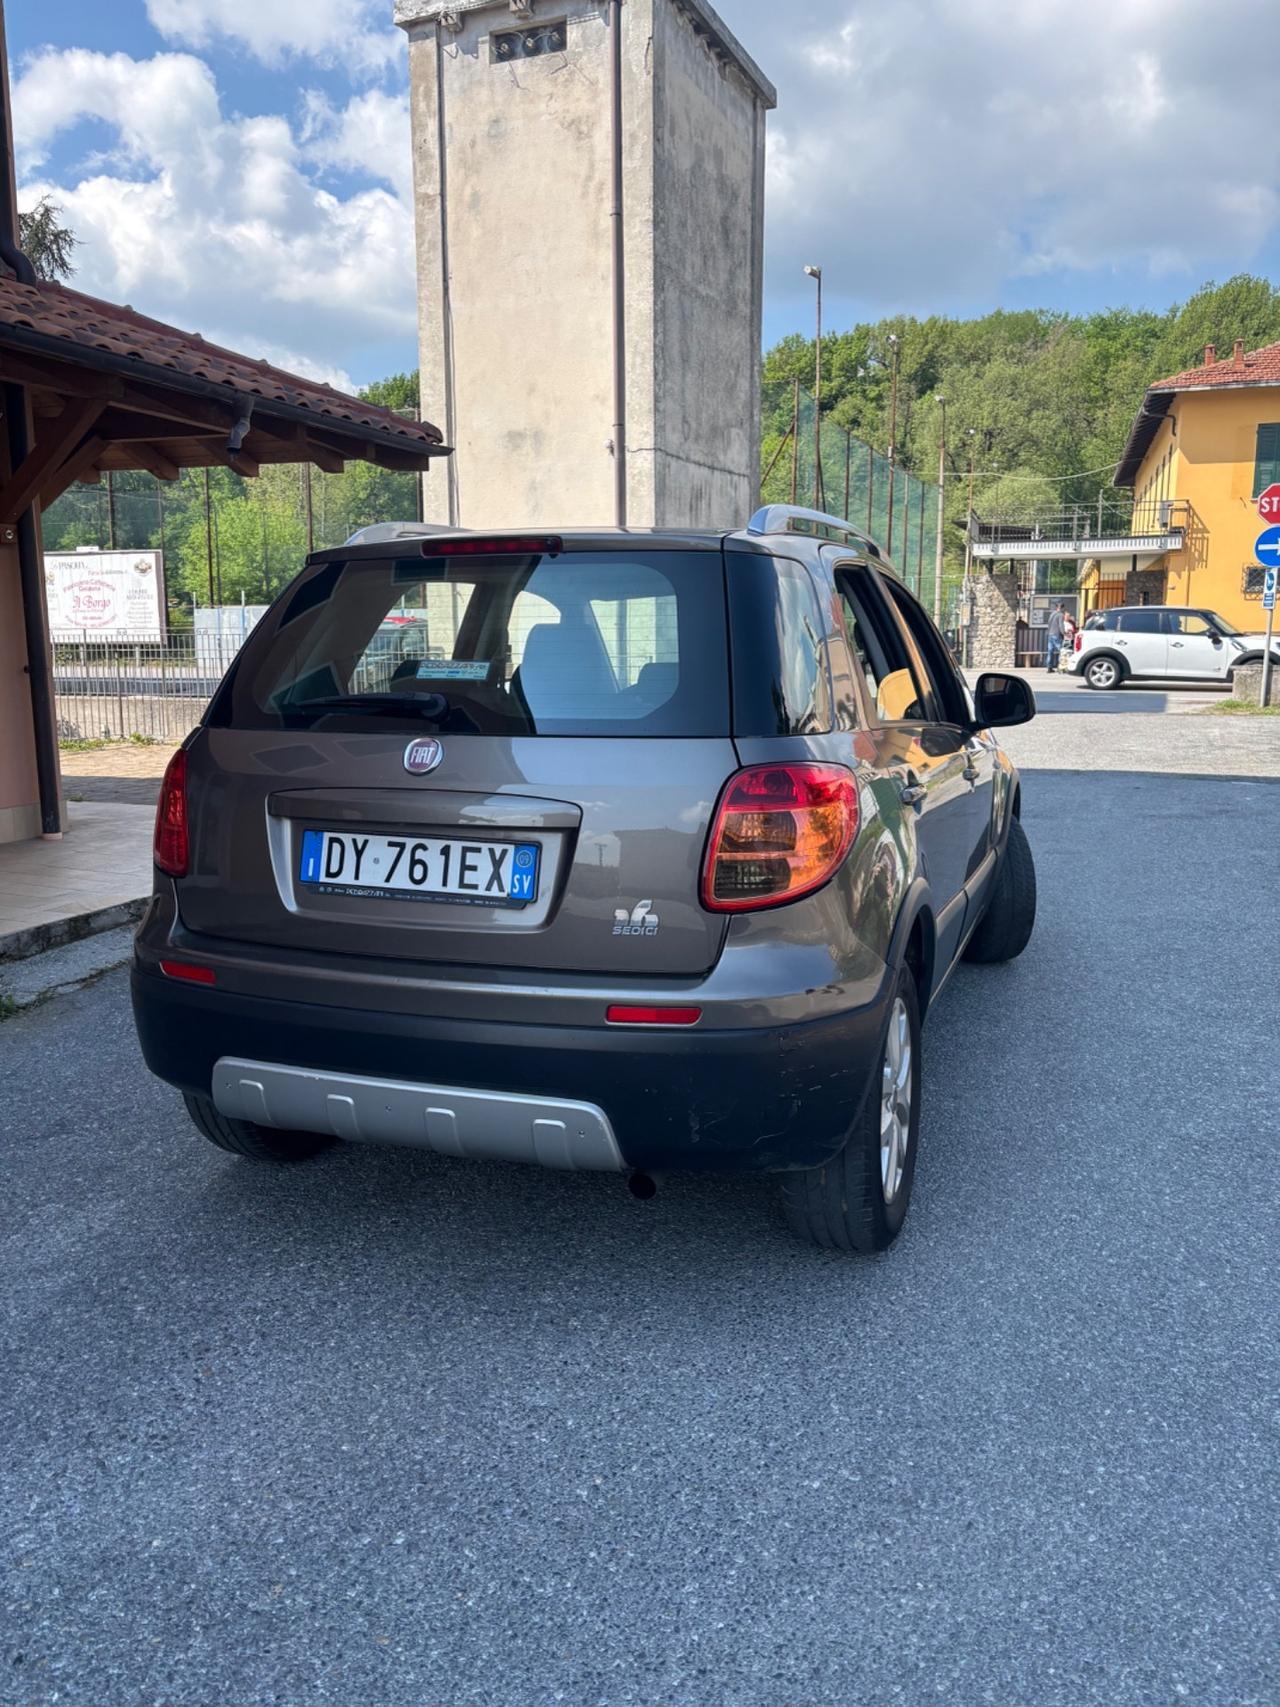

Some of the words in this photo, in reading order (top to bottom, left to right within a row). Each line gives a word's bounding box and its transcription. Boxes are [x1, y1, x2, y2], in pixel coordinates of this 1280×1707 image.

[1260, 497, 1280, 513] ST
[410, 747, 435, 764] FIAT
[325, 836, 370, 881] DY
[384, 840, 509, 895] 761EX
[512, 874, 532, 895] SV
[612, 926, 658, 936] SEDICI
